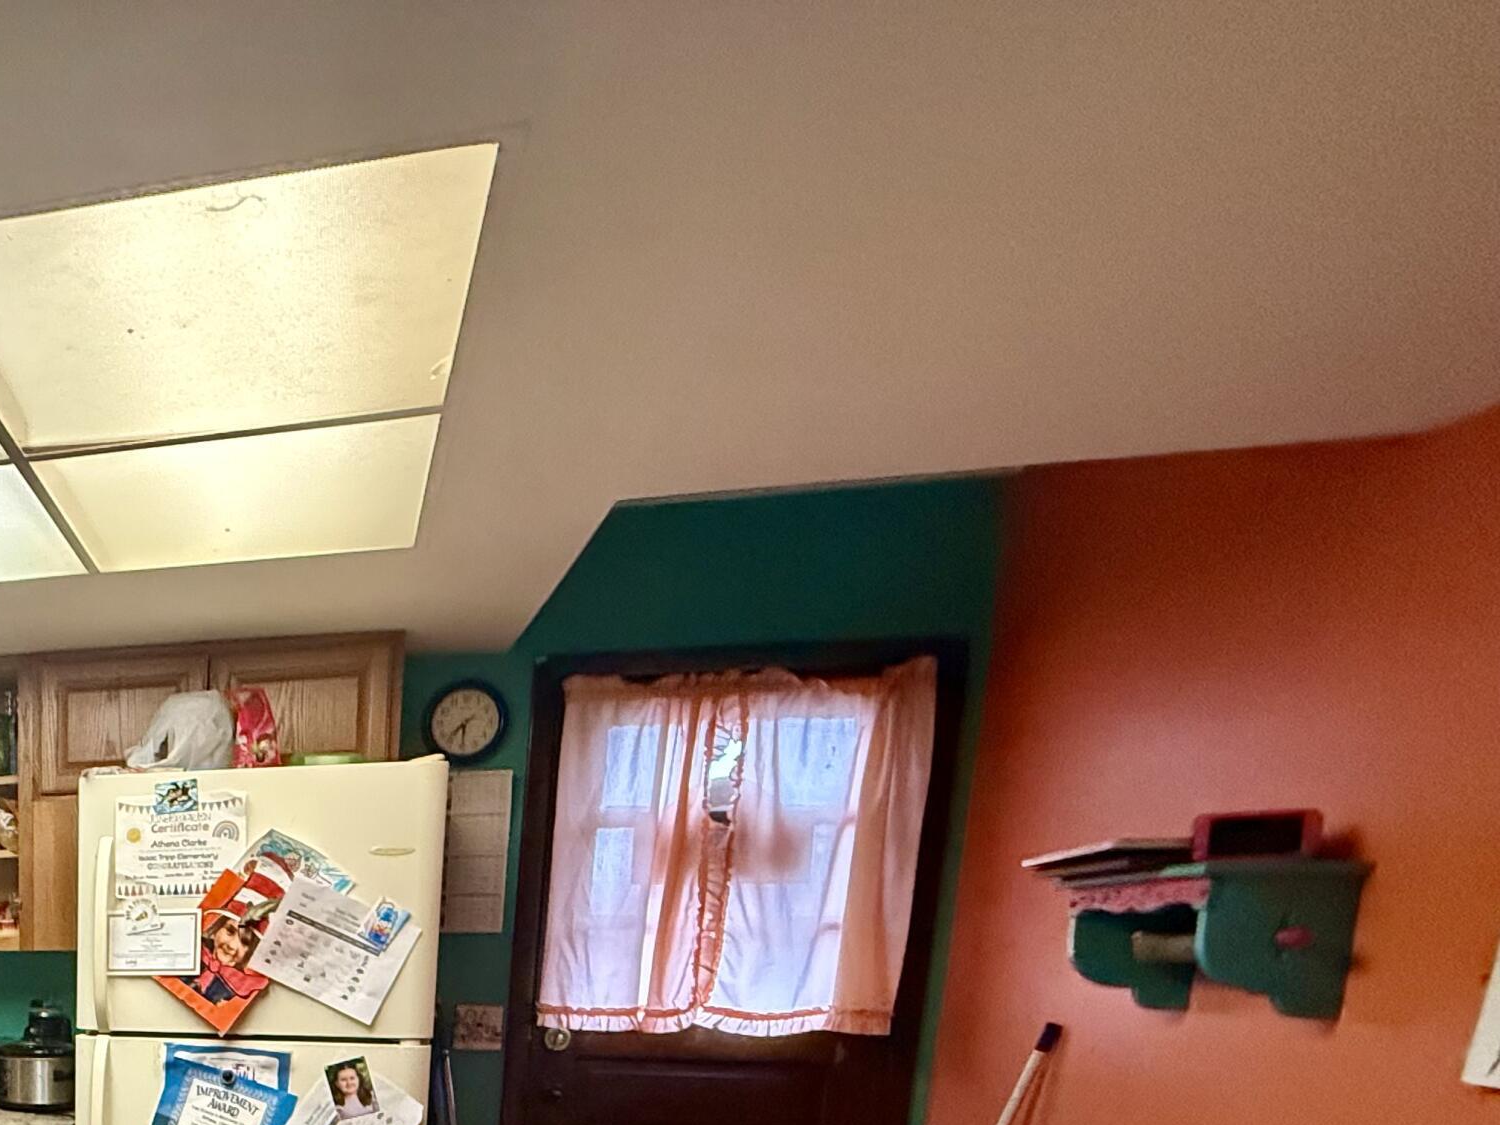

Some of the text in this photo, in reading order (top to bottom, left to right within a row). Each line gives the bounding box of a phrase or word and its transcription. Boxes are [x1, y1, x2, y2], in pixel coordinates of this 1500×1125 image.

[151, 822, 210, 834] Certificate
[150, 838, 208, 848] Athena Clarke
[196, 1084, 260, 1116] IMPROVEMENT
[207, 1097, 240, 1117] AWARD
